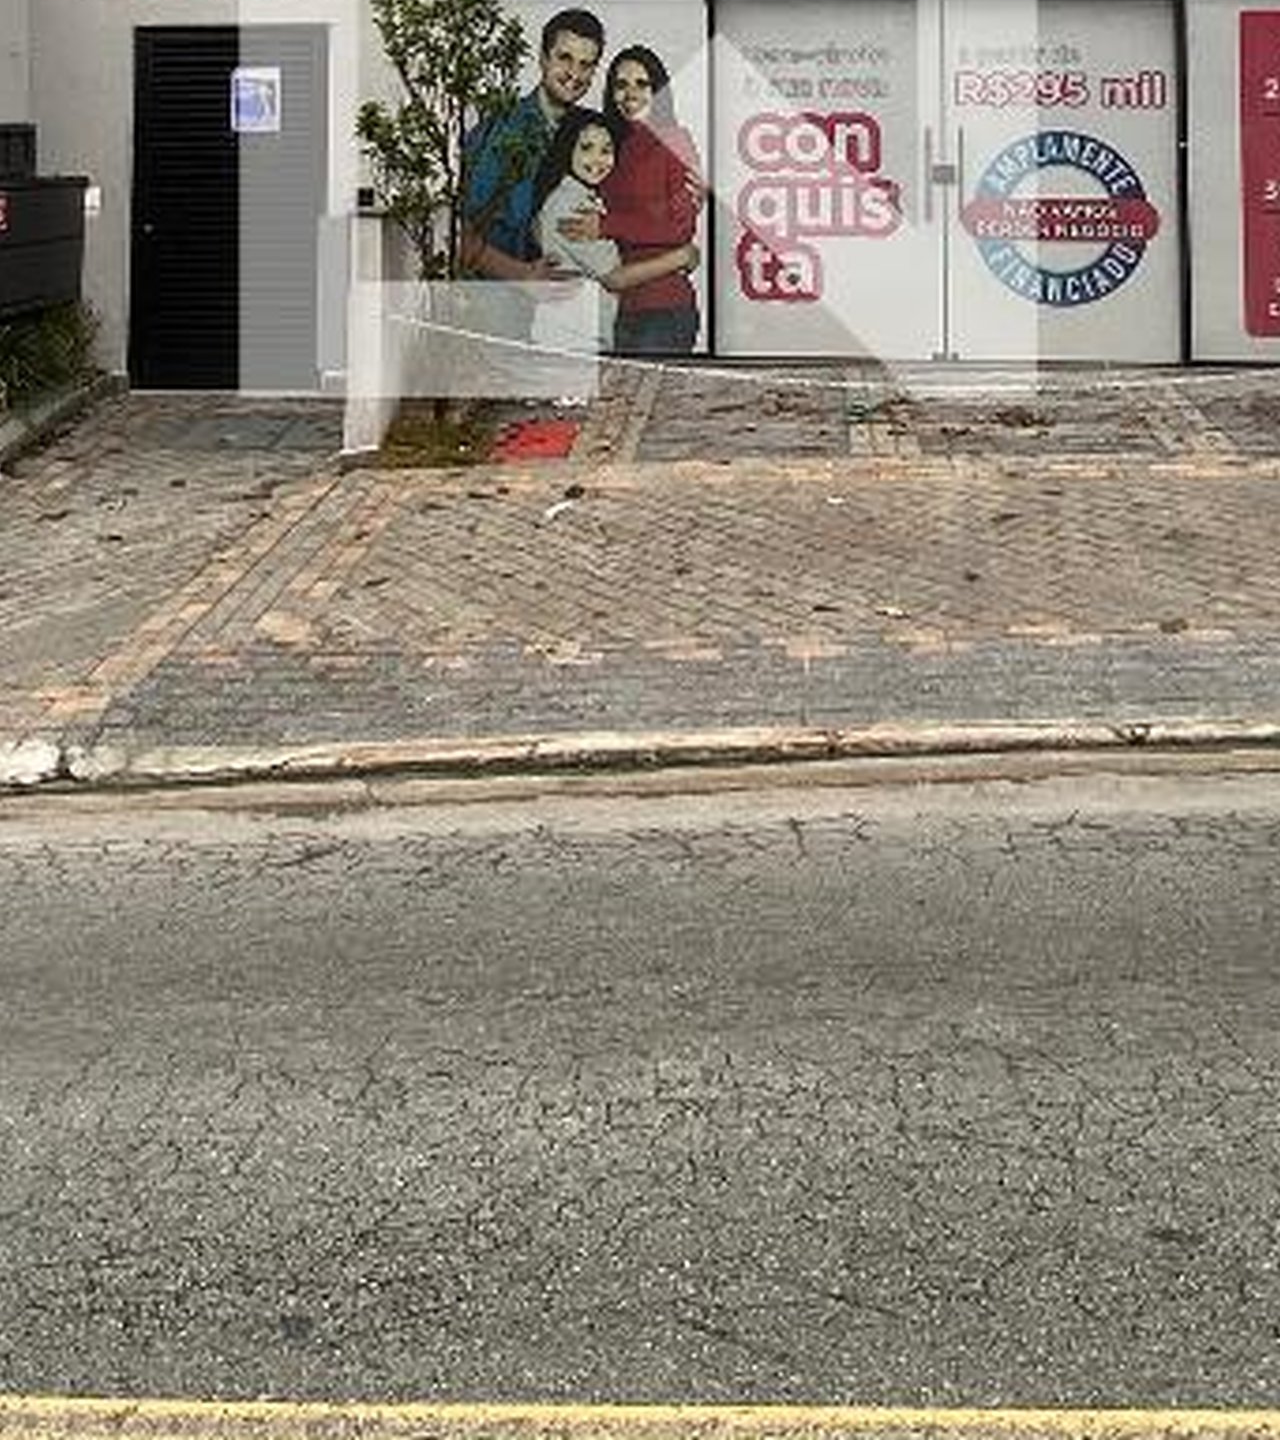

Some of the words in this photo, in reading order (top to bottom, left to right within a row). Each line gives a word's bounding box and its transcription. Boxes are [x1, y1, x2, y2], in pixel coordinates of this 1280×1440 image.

[954, 71, 1090, 108] R$295
[1100, 70, 1166, 109] mil
[1264, 78, 1280, 100] 2
[742, 116, 877, 169] con
[742, 182, 899, 236] quis
[740, 236, 820, 299] ta
